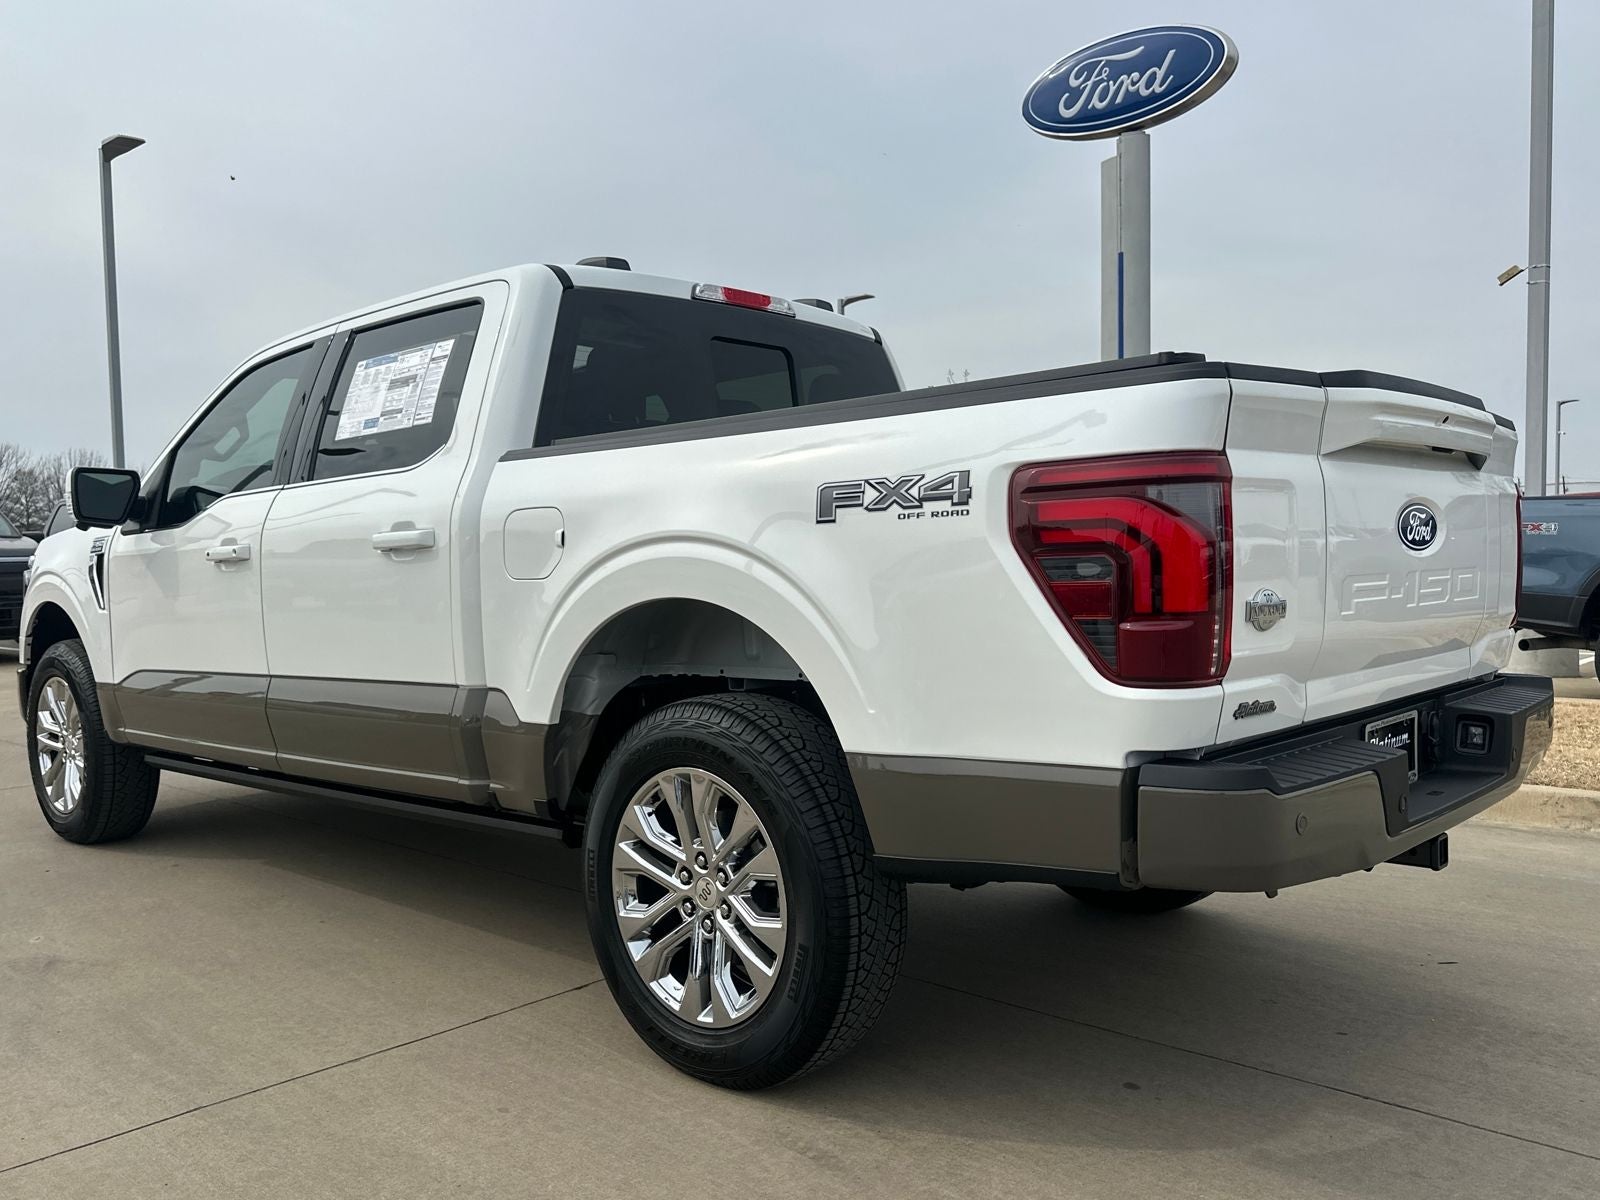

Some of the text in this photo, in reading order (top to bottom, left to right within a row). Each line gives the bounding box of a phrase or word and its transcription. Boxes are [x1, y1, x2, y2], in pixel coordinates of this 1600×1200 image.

[1058, 46, 1176, 118] Ford
[816, 470, 972, 524] FX4
[931, 509, 970, 518] ROAD
[1407, 511, 1432, 541] Ford
[1341, 567, 1480, 615] F-150
